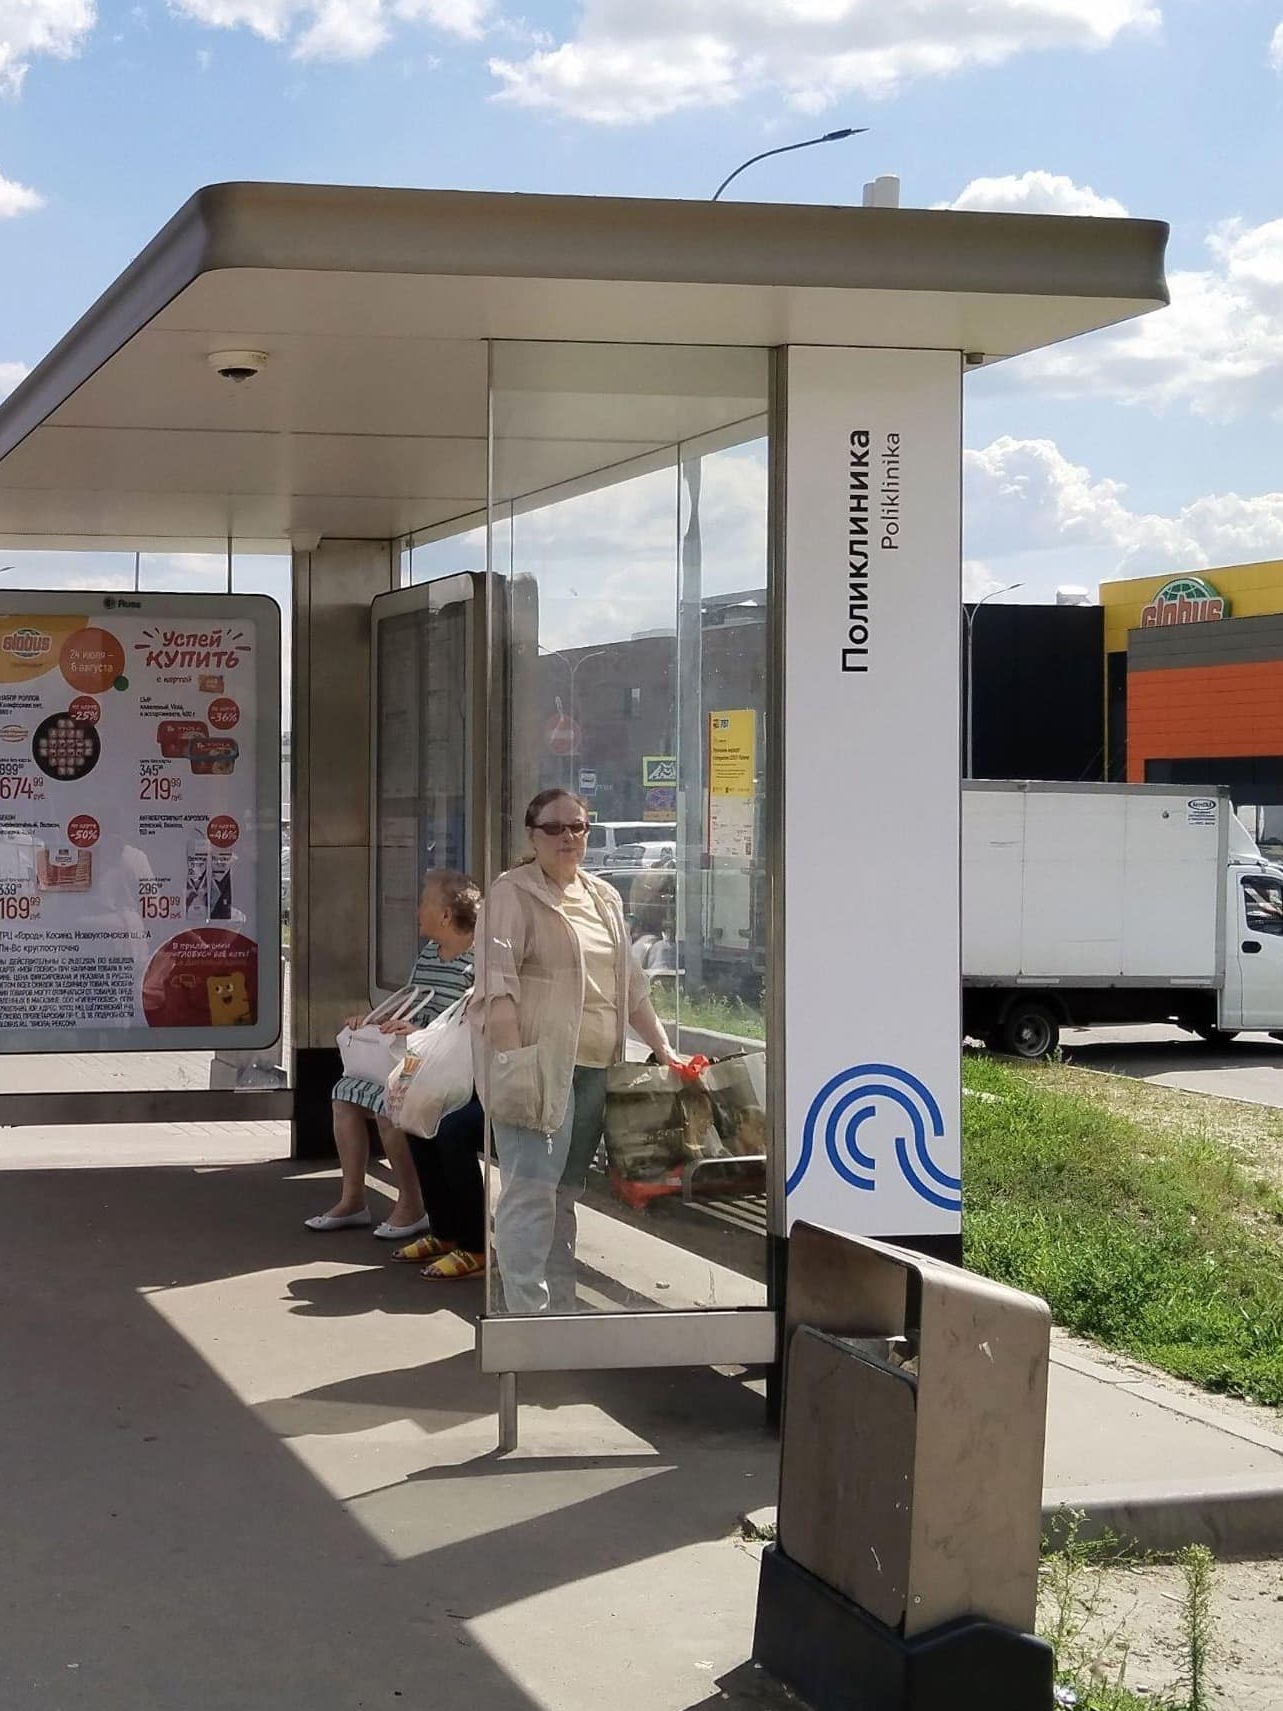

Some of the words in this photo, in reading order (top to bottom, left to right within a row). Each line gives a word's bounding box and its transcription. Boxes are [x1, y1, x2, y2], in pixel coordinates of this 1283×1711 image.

[881, 432, 901, 550] Poliklinika
[841, 430, 870, 673] Поликлиника
[69, 648, 80, 660] 24
[146, 650, 240, 669] КУПИТЬ
[71, 711, 98, 721] -25%
[211, 712, 237, 722] -36%
[0, 763, 18, 775] 899
[140, 764, 158, 776] 345
[0, 777, 33, 800] 674
[140, 777, 171, 800] 219
[70, 829, 98, 840] -50%
[139, 883, 157, 895] 296
[139, 896, 170, 919] 159
